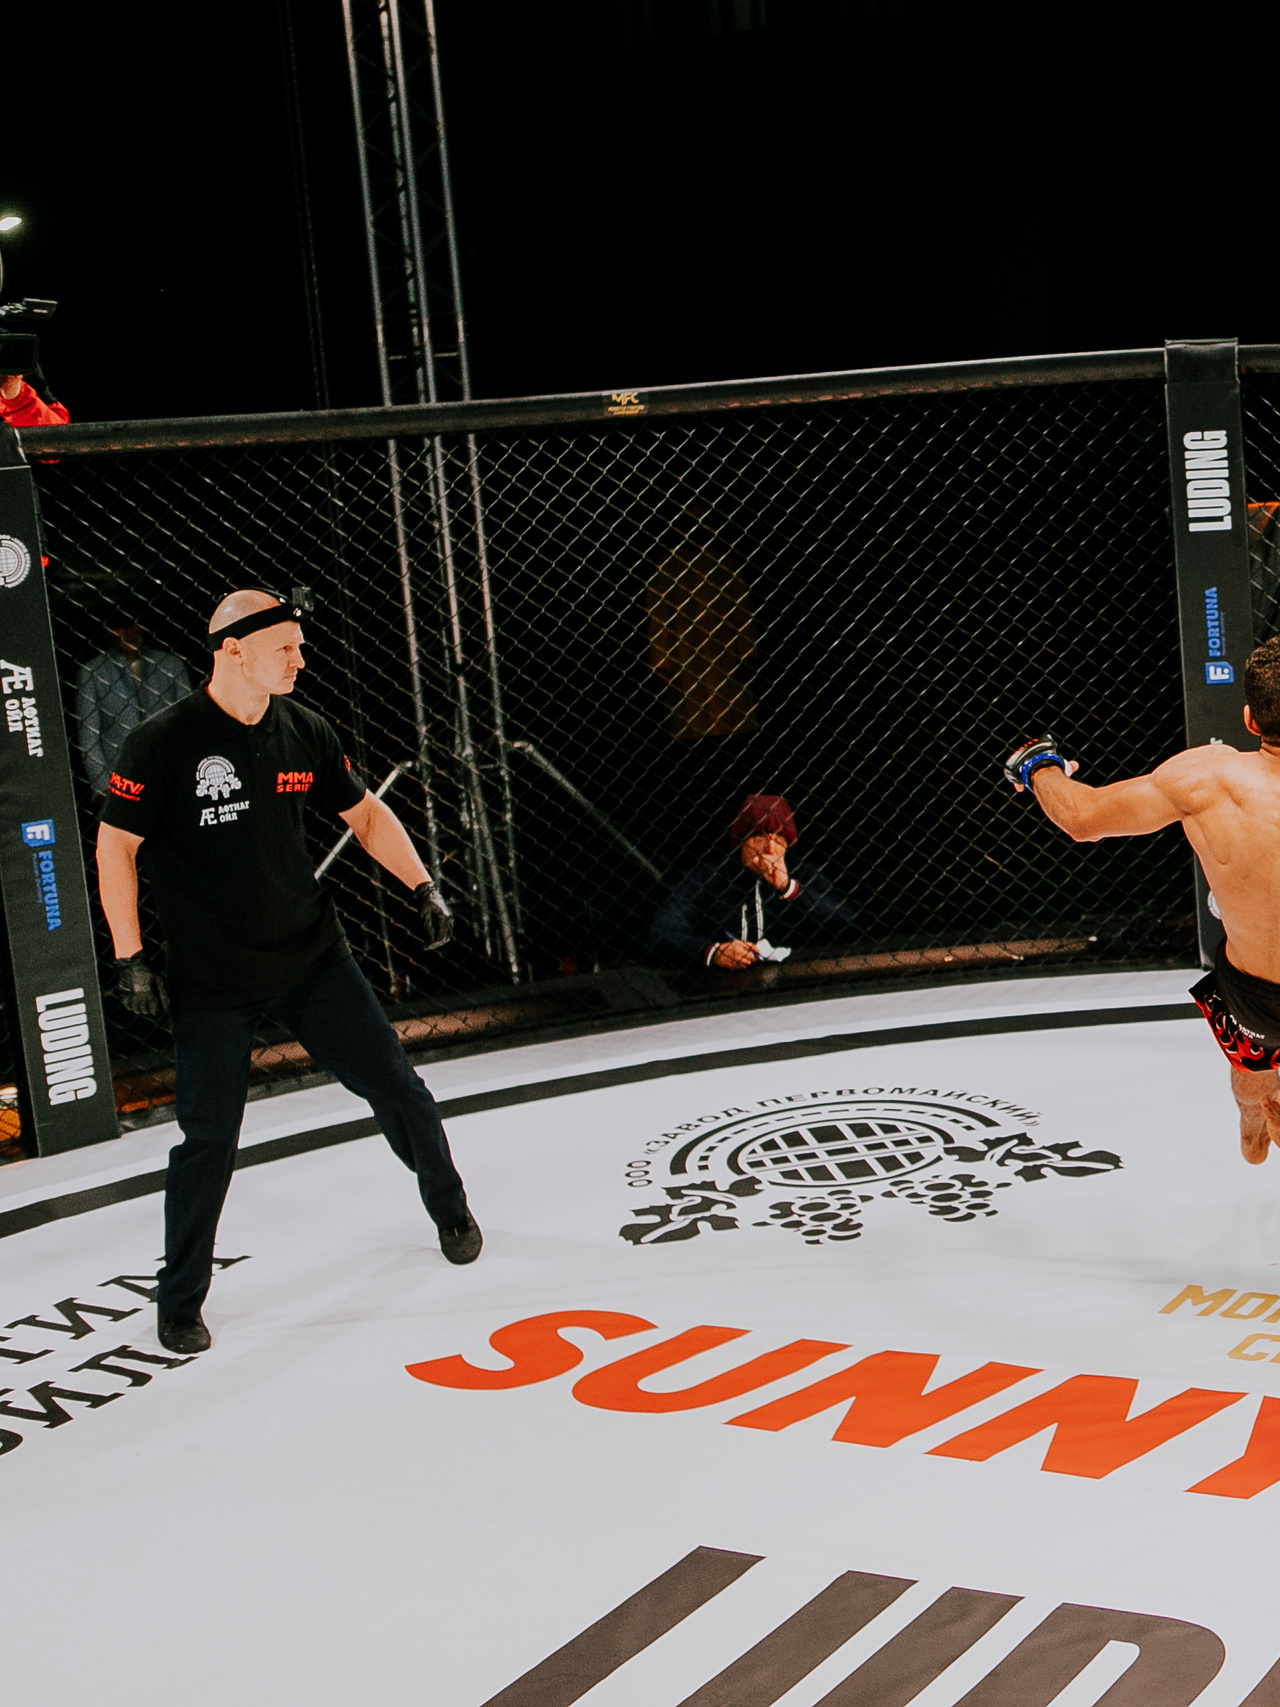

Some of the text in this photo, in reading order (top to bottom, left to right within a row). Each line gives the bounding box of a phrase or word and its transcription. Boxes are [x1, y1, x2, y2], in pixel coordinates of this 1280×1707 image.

[611, 391, 639, 405] MFC
[1183, 430, 1233, 532] LUDING
[1204, 586, 1221, 657] FORTUNA
[277, 771, 314, 784] MMA
[38, 850, 62, 932] FORTUNA
[35, 987, 97, 1106] LUDING
[624, 1159, 653, 1188] ООО
[644, 1106, 750, 1155] «ЗАВОД
